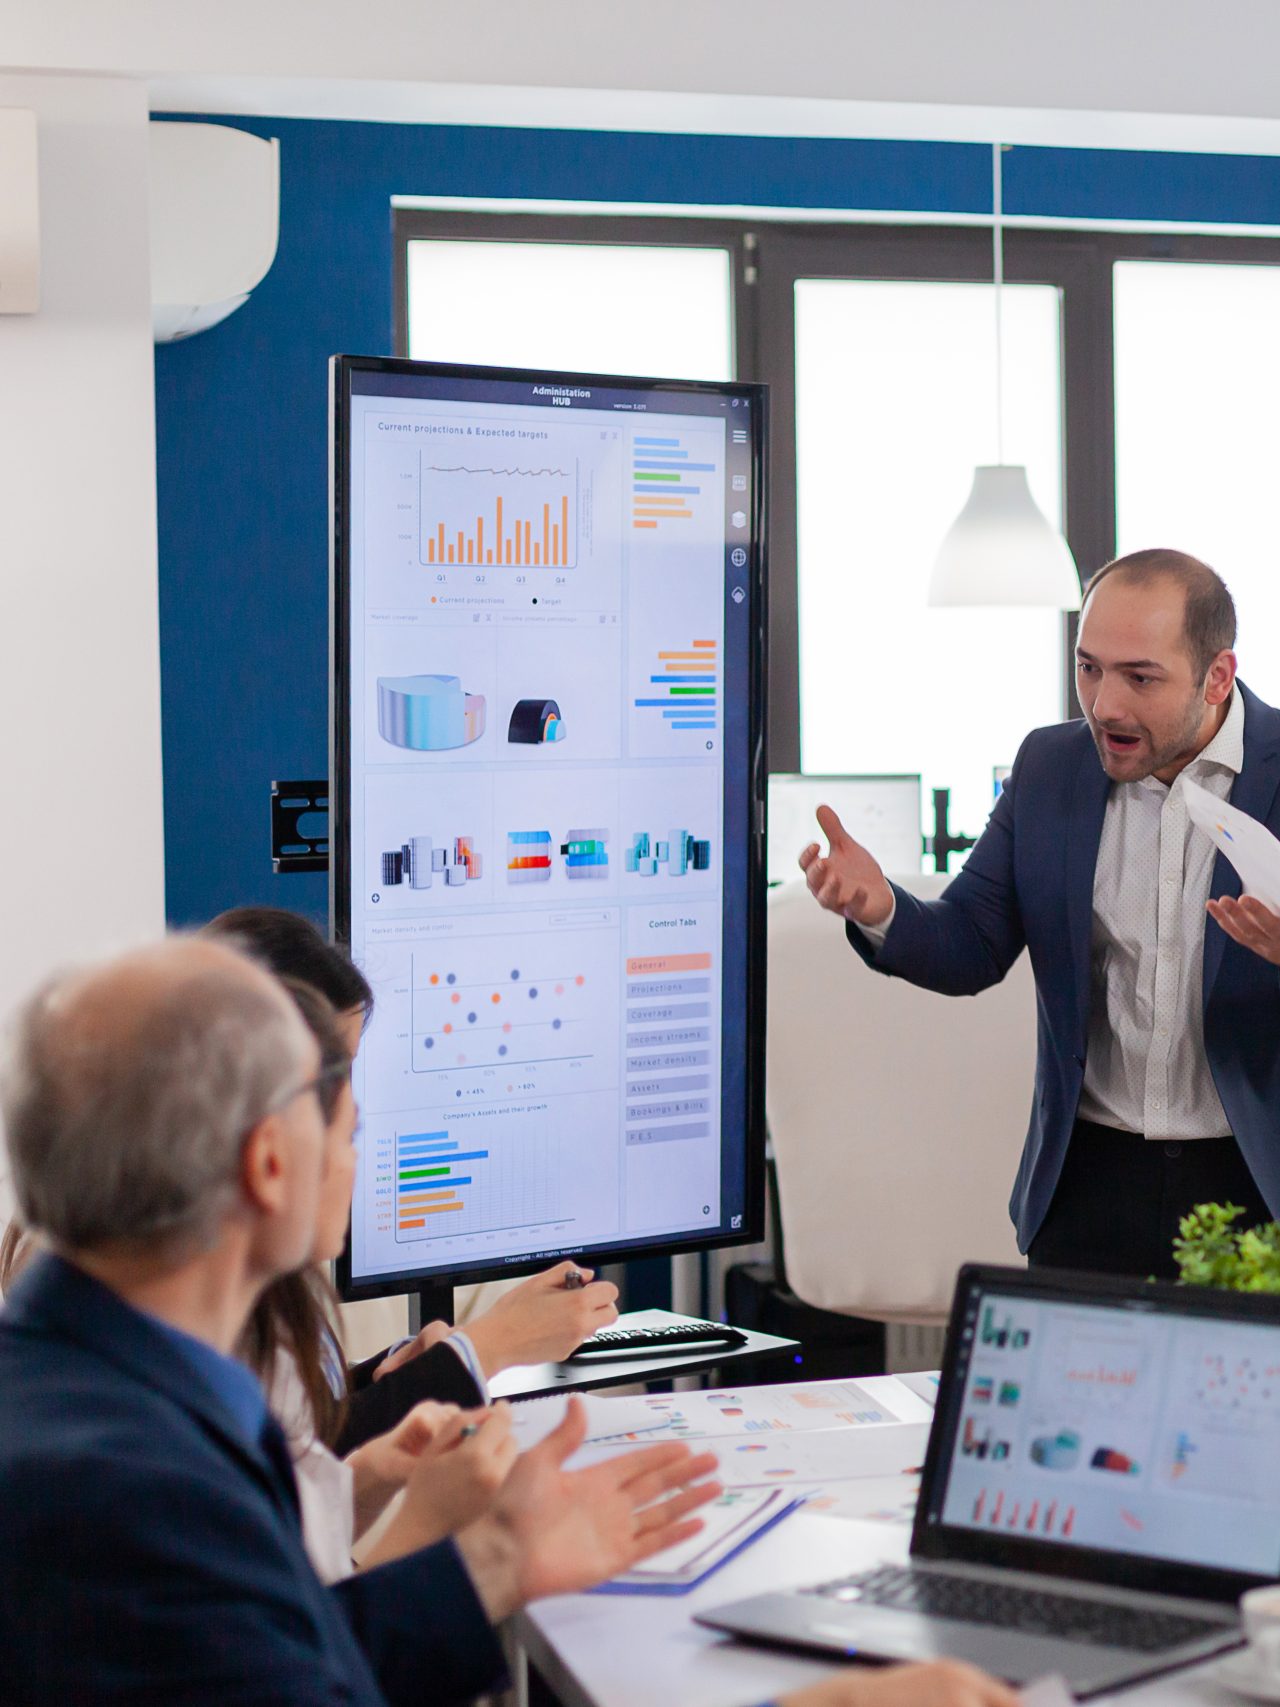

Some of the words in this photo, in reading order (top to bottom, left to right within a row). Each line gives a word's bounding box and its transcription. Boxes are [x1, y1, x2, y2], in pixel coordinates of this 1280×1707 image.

[533, 386, 591, 398] Administation
[552, 397, 571, 406] HUB
[378, 422, 412, 432] Current
[414, 424, 464, 436] projections
[467, 428, 473, 436] &
[475, 427, 516, 438] Expected
[518, 430, 549, 440] targets
[649, 919, 677, 928] Control
[680, 918, 697, 926] Tabs
[631, 961, 666, 970] General
[631, 984, 682, 994] Projections
[631, 1009, 672, 1020] Coverage
[631, 1083, 660, 1092] Assets
[443, 1110, 476, 1121] Company's
[477, 1109, 497, 1117] Assets
